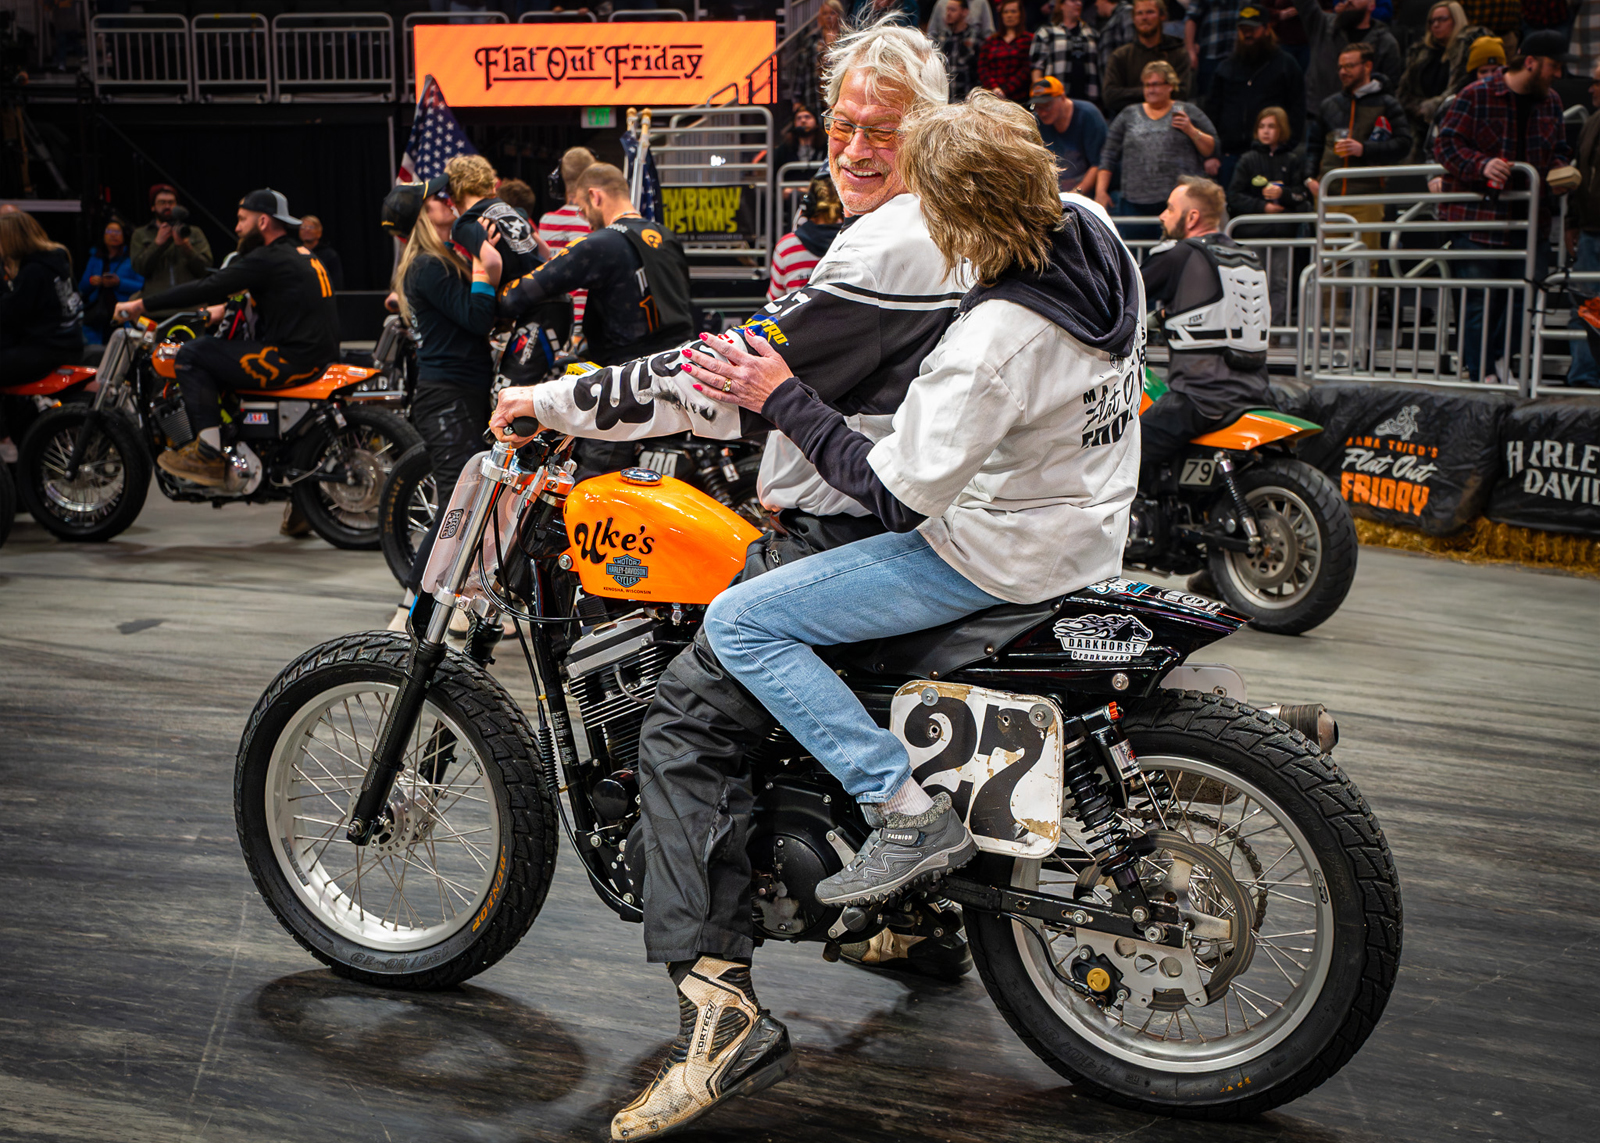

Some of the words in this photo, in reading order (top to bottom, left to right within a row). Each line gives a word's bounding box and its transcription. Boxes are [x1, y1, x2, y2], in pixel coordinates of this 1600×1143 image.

[474, 44, 537, 91] Flat
[547, 46, 595, 81] Out
[604, 44, 703, 89] Friday
[662, 186, 742, 211] WBROW
[664, 208, 738, 234] USTOMS
[1188, 313, 1204, 324] FOX
[1184, 461, 1212, 483] 79
[1341, 447, 1394, 475] Flat
[1392, 455, 1439, 483] Out
[1341, 471, 1431, 517] FRIDAY
[574, 516, 656, 565] Uke's
[608, 565, 646, 576] HARLEY-DAVIDSON
[616, 557, 638, 566] MOTOR
[616, 575, 638, 586] CYCLES
[1068, 638, 1139, 653] DARKHORSE
[1072, 650, 1130, 661] Crankworks
[903, 696, 1050, 842] 27
[887, 833, 913, 841] FASHION
[472, 853, 507, 933] DUNLOP
[696, 1001, 717, 1057] CORTECH
